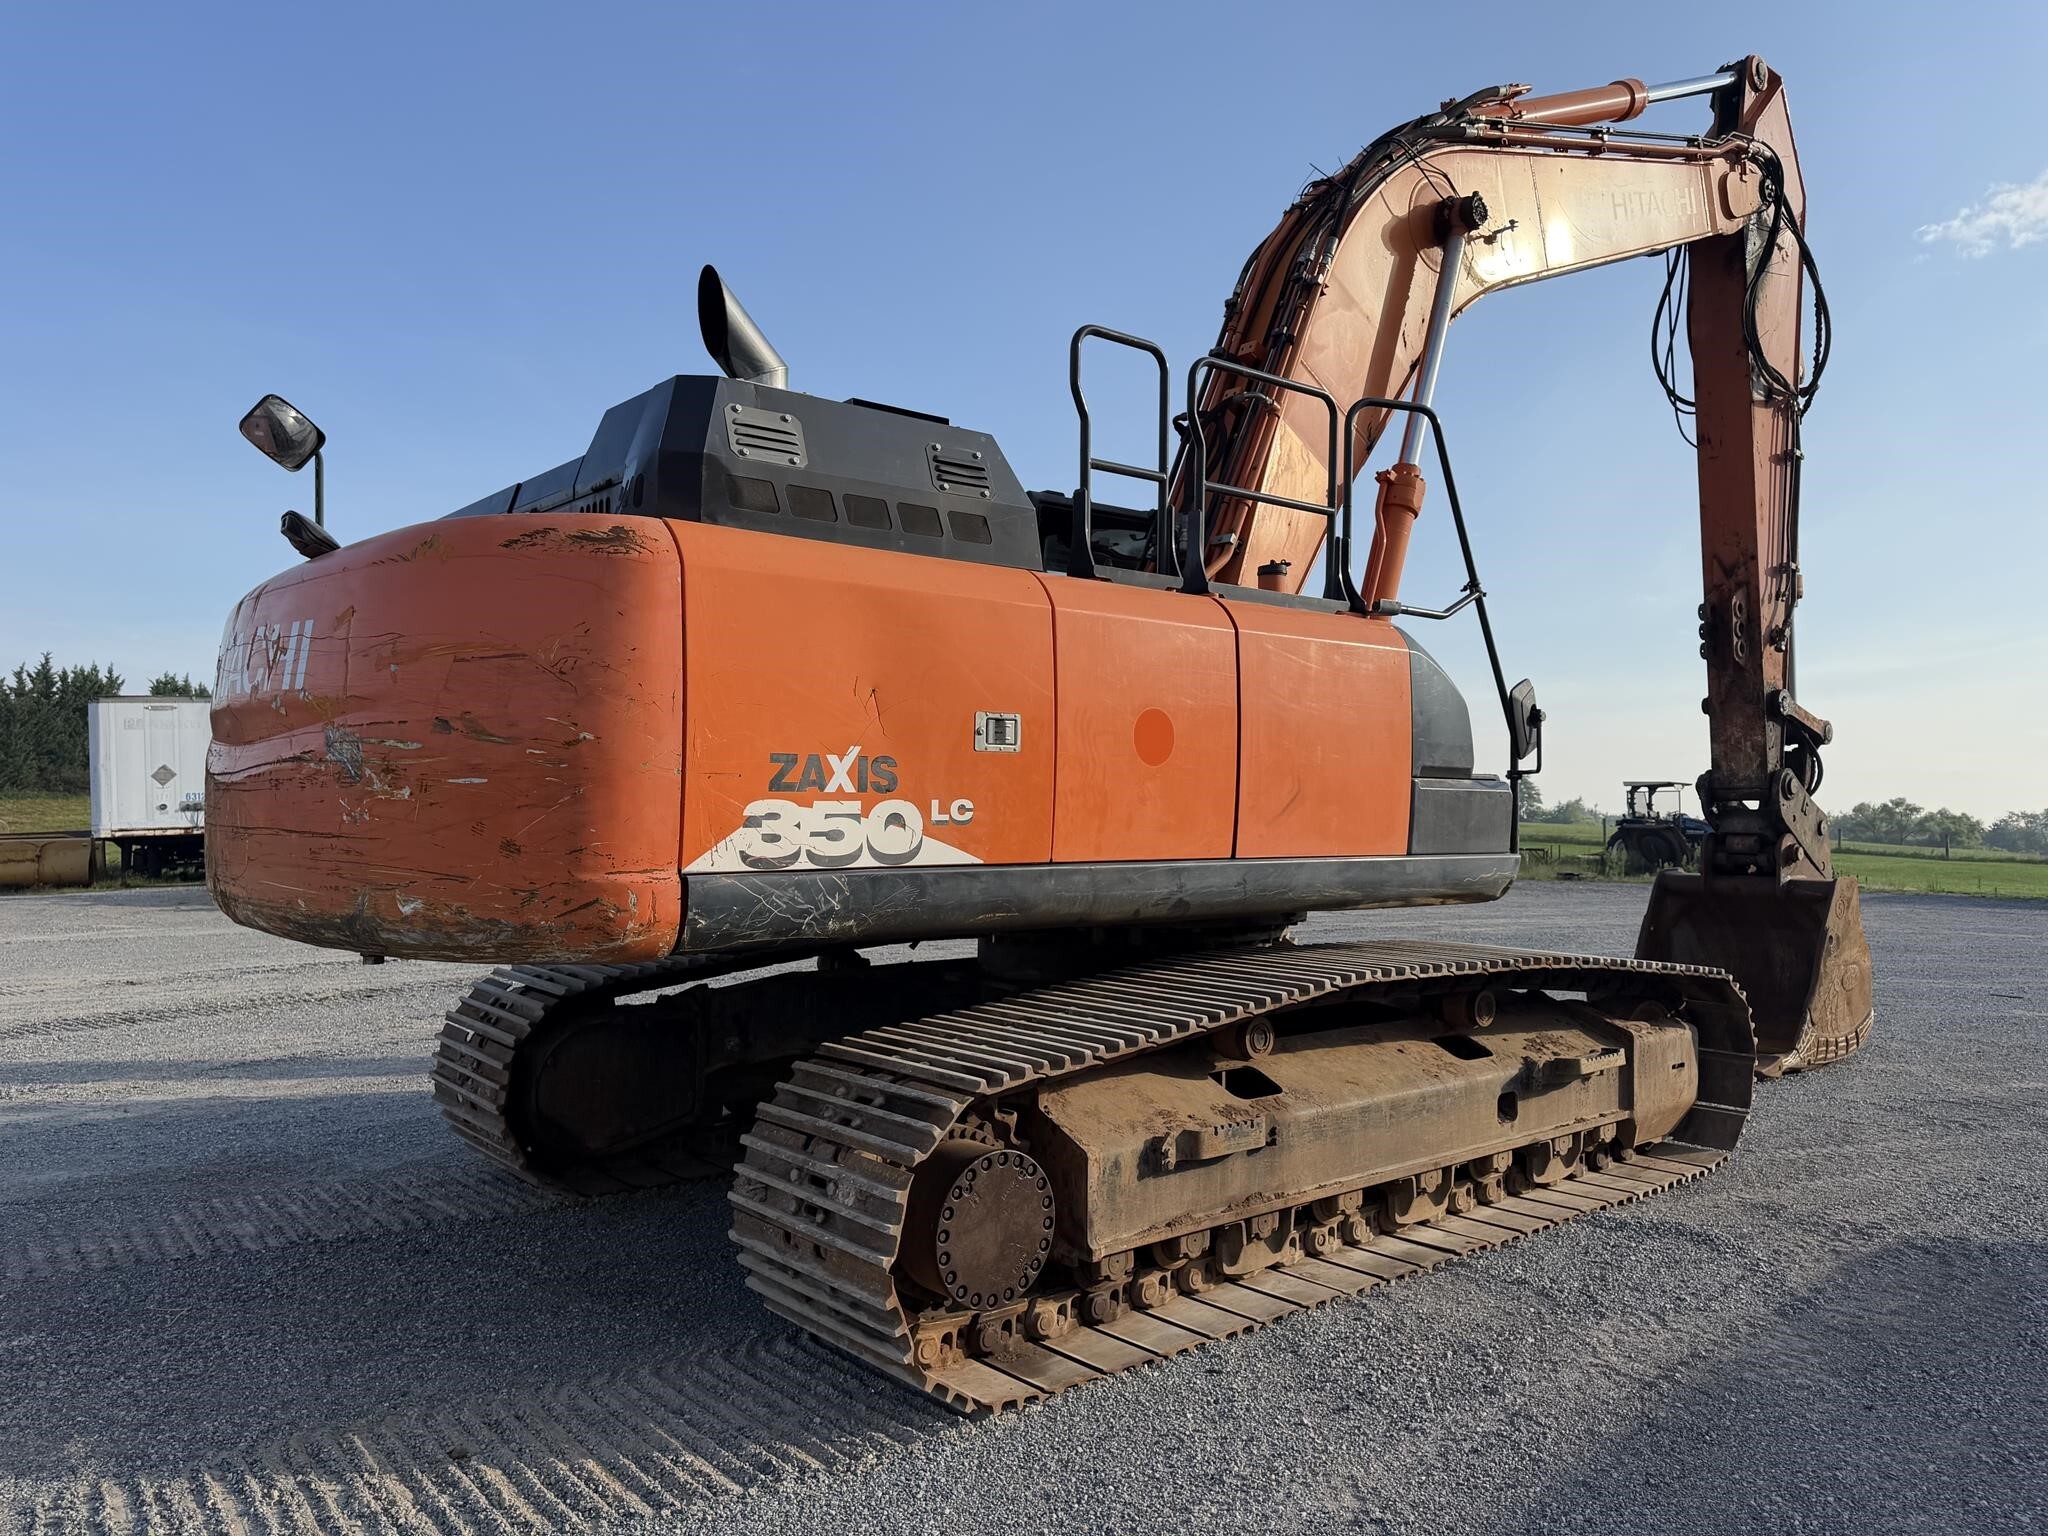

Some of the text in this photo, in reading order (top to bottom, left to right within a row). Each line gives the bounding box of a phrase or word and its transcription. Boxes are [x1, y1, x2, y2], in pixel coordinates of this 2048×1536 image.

[1611, 187, 1697, 220] HITACHI
[768, 745, 898, 794] ZAXIS
[739, 799, 974, 869] 350 LC
